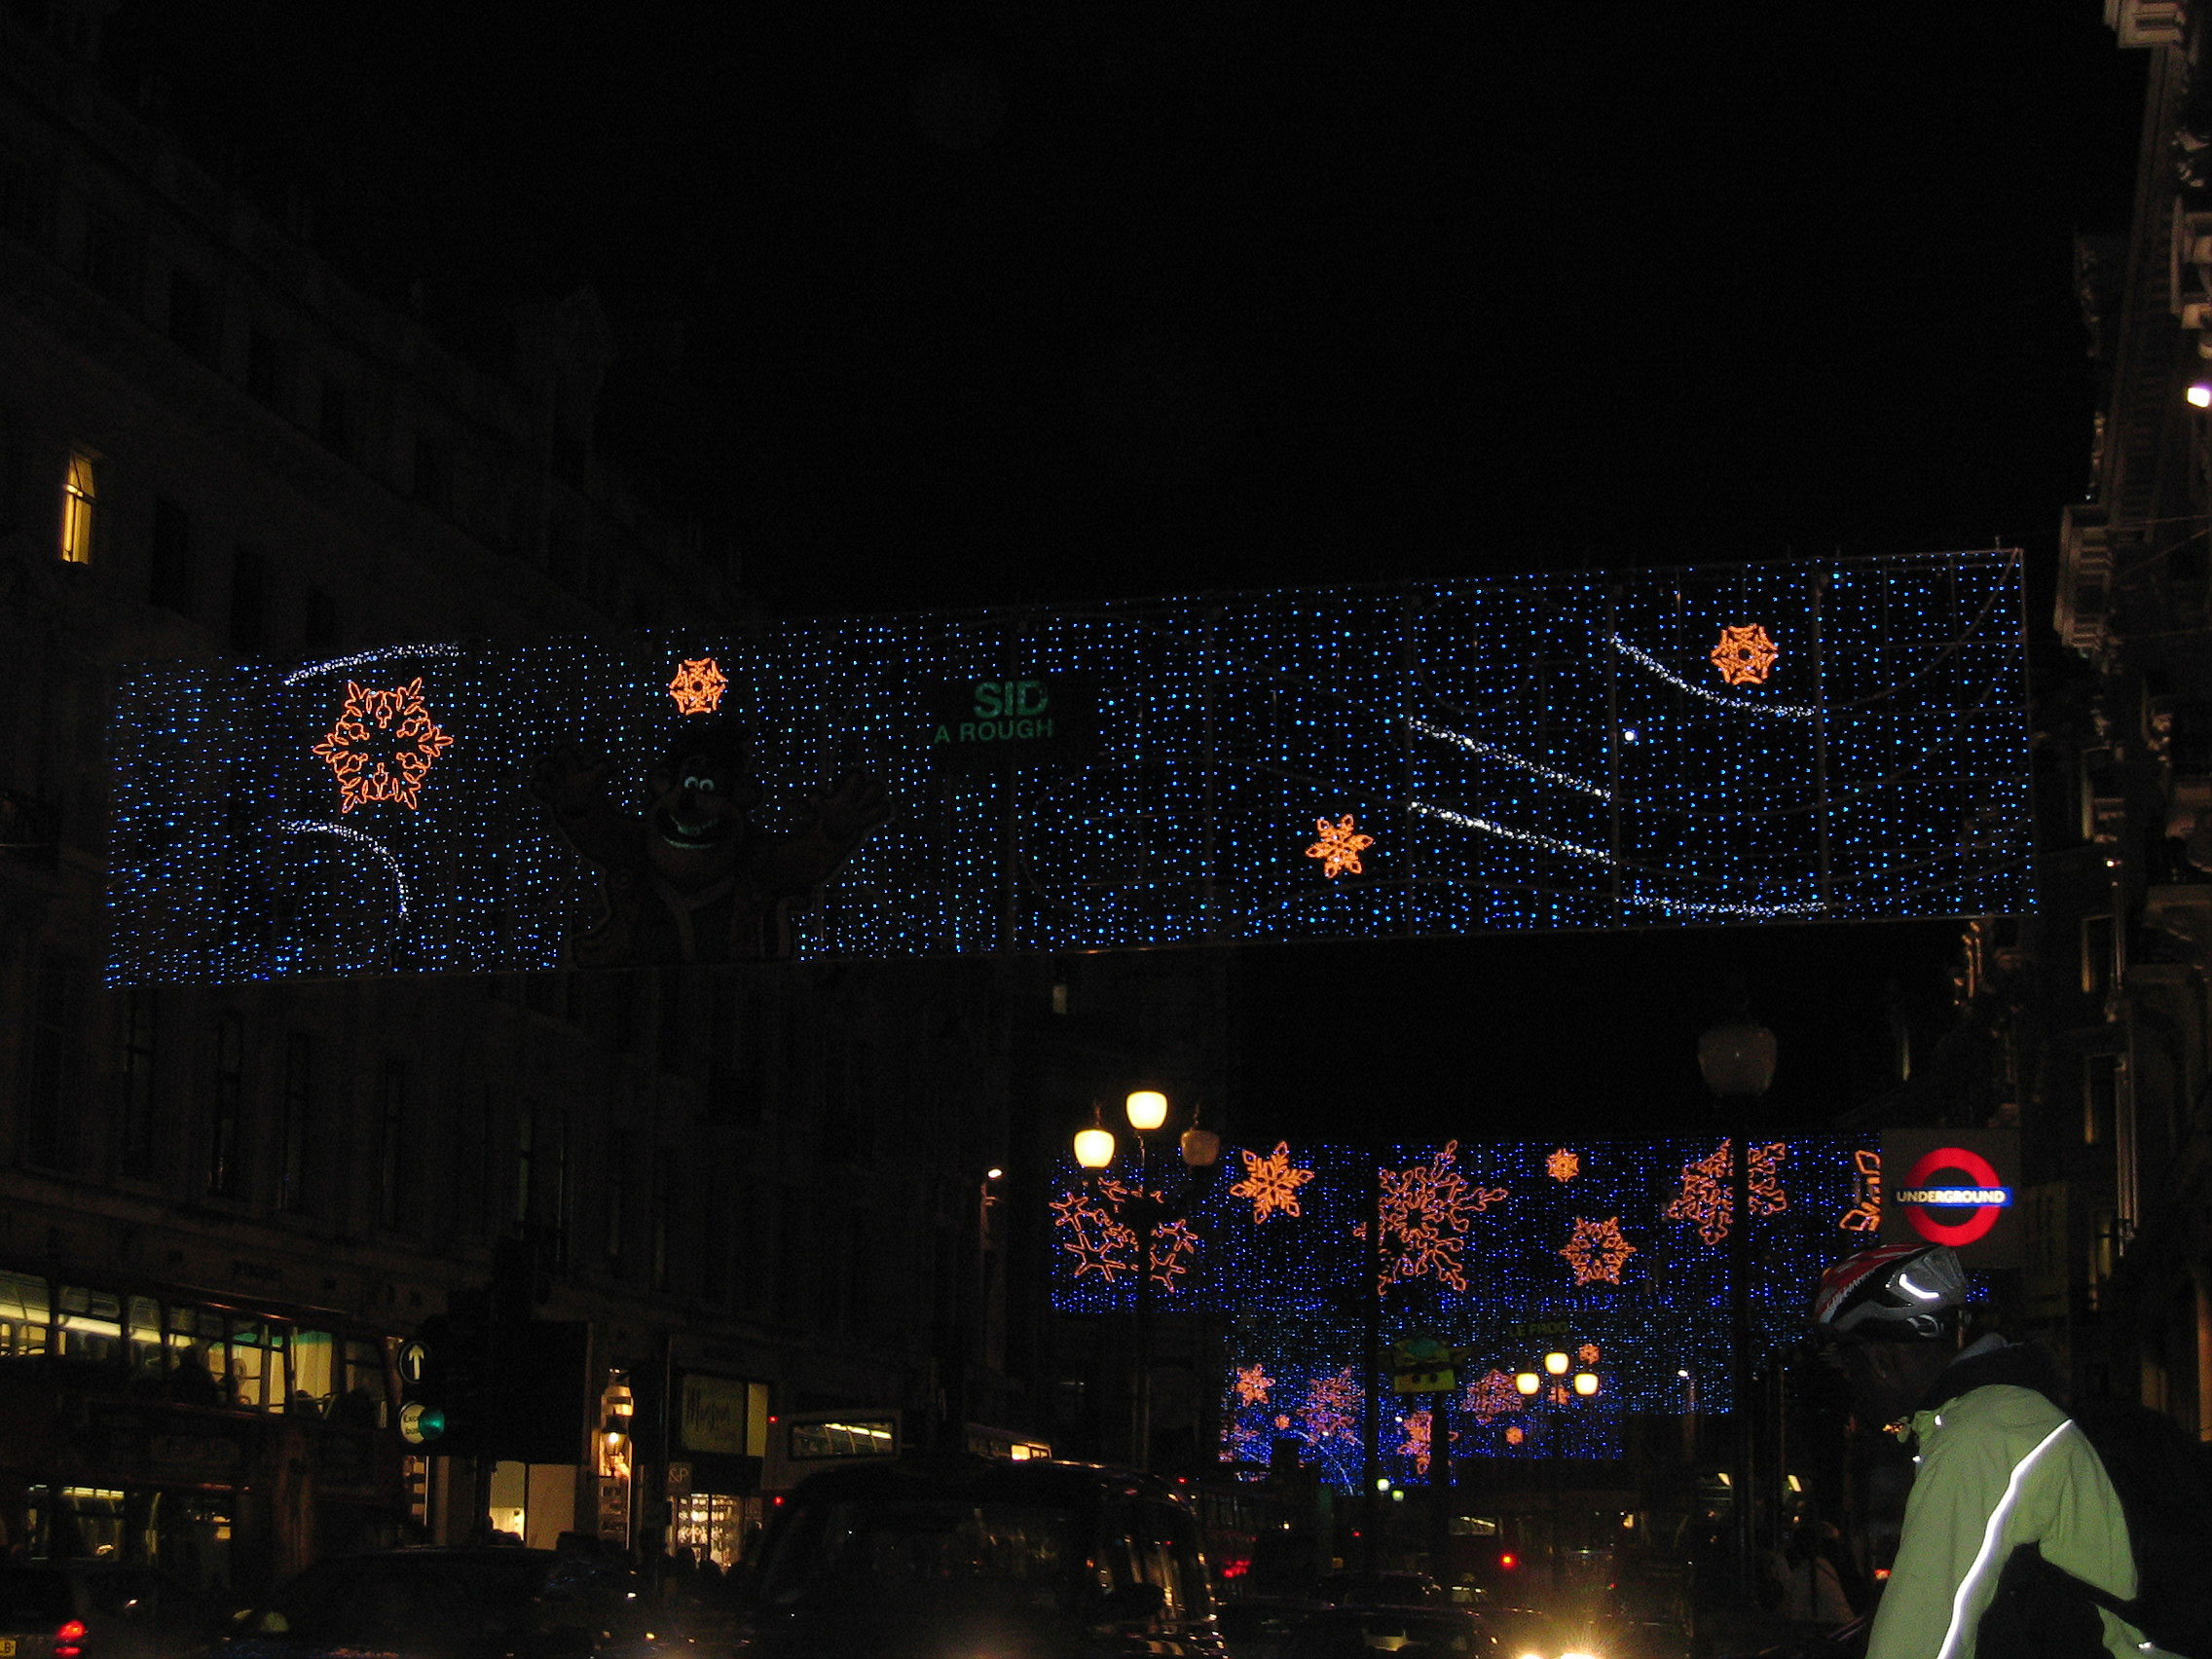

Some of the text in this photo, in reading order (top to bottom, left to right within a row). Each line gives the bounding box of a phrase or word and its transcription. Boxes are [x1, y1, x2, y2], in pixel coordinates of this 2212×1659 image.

[974, 681, 1049, 719] SID
[935, 719, 1054, 744] A ROUGH
[1896, 1190, 2007, 1203] UNDERGROUND
